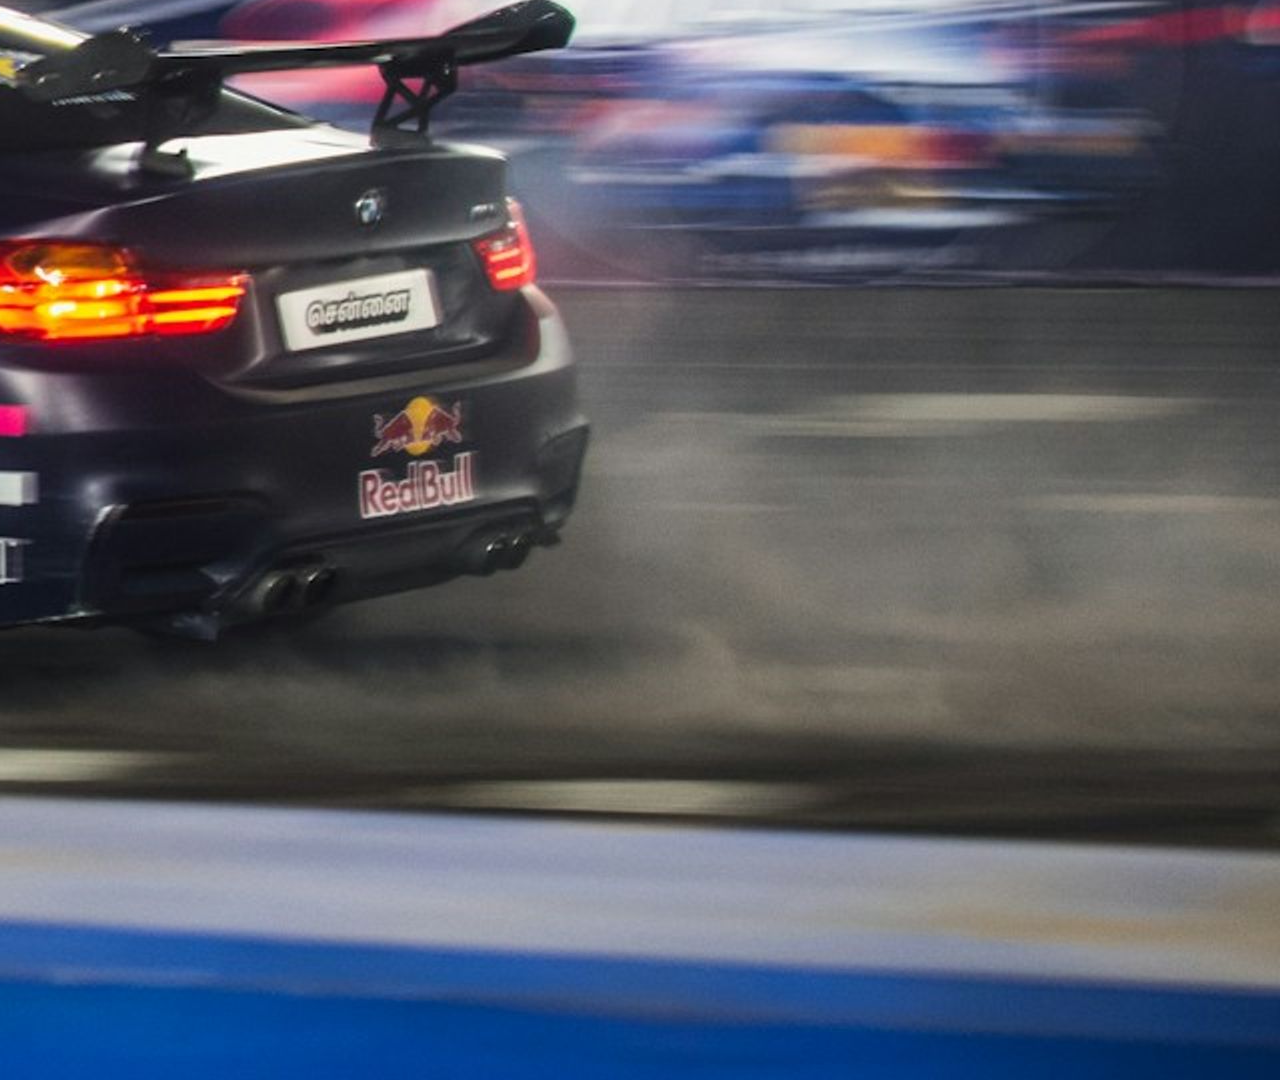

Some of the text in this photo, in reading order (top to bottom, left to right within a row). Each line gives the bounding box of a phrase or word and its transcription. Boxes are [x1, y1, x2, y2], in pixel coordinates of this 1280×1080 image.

[304, 291, 410, 335] சென்னை
[359, 452, 476, 518] Red Bull
